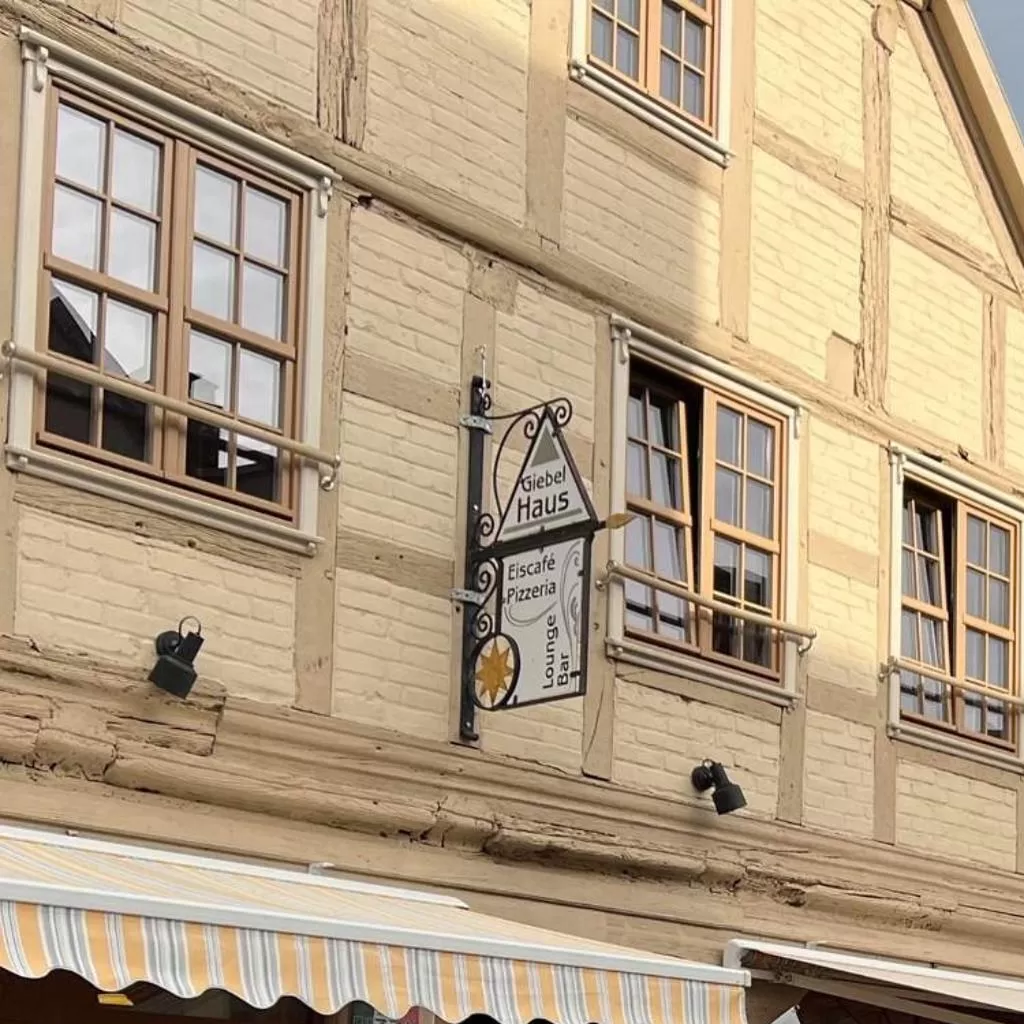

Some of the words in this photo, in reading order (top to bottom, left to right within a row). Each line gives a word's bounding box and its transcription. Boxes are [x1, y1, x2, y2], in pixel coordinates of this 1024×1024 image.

[521, 464, 566, 492] Giebel
[517, 491, 569, 523] Haus
[508, 553, 556, 581] Eiscafé
[507, 579, 556, 604] Pizzeria
[542, 614, 559, 689] Lounge
[557, 652, 569, 687] Bar
